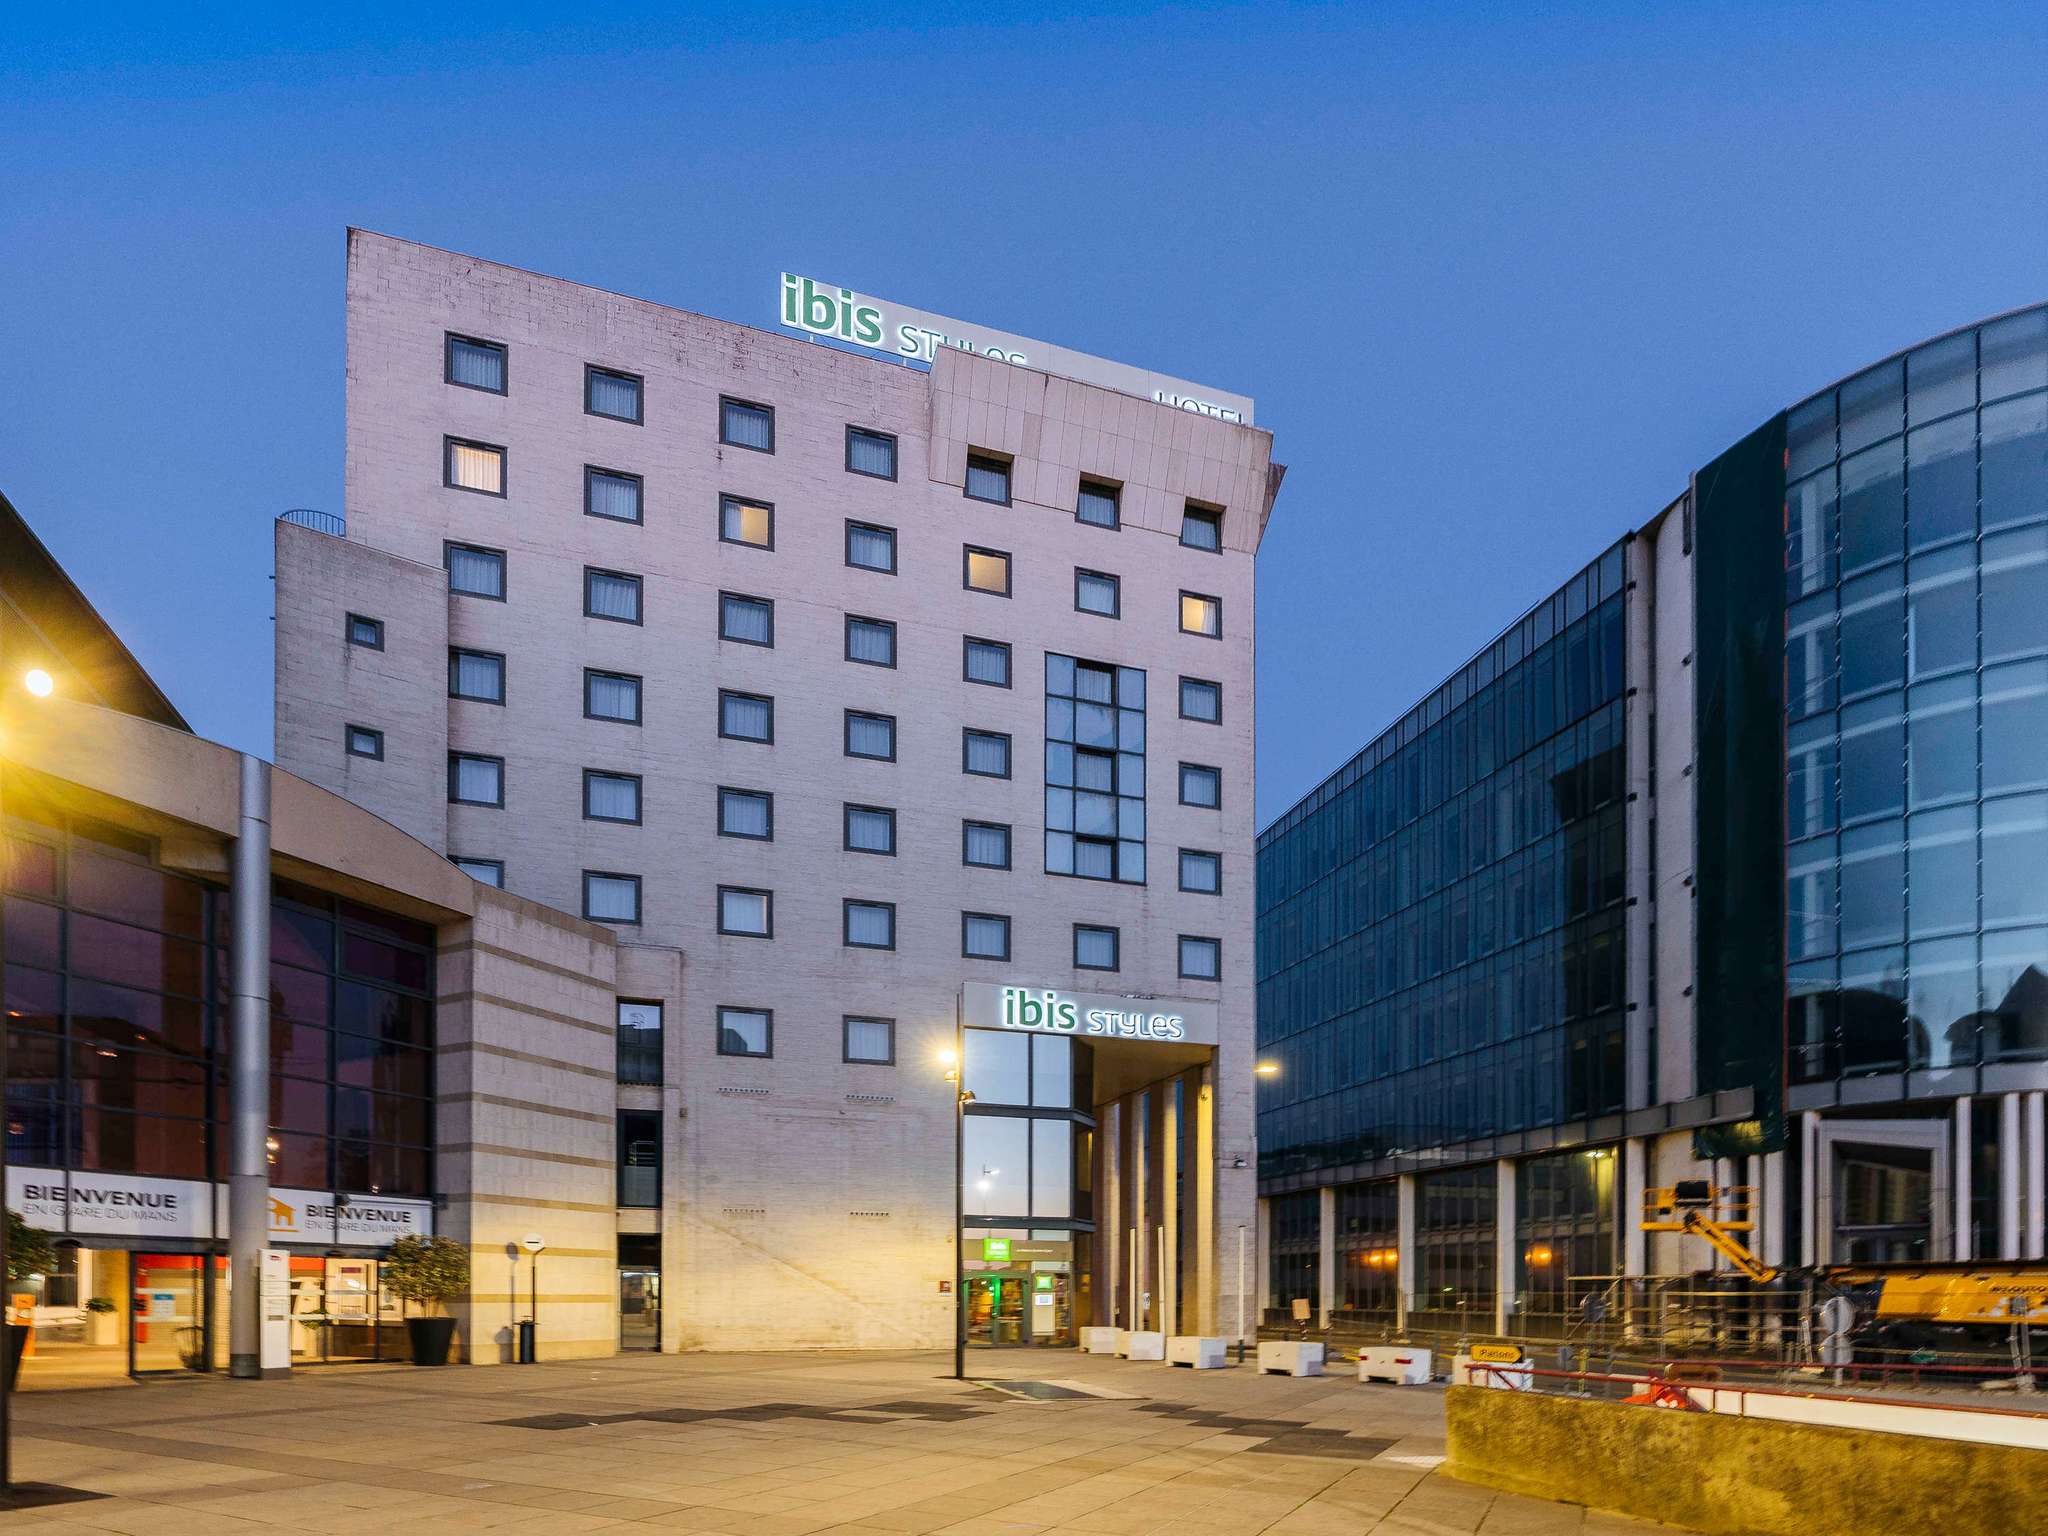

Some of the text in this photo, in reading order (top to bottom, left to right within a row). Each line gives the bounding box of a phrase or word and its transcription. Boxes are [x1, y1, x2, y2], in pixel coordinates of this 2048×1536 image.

[785, 273, 882, 344] ibis
[1006, 989, 1076, 1030] ibis
[24, 1183, 178, 1209] BIENVENUE
[53, 1204, 103, 1219] GARE
[106, 1208, 130, 1220] DU
[306, 1204, 412, 1223] BIENVENUE
